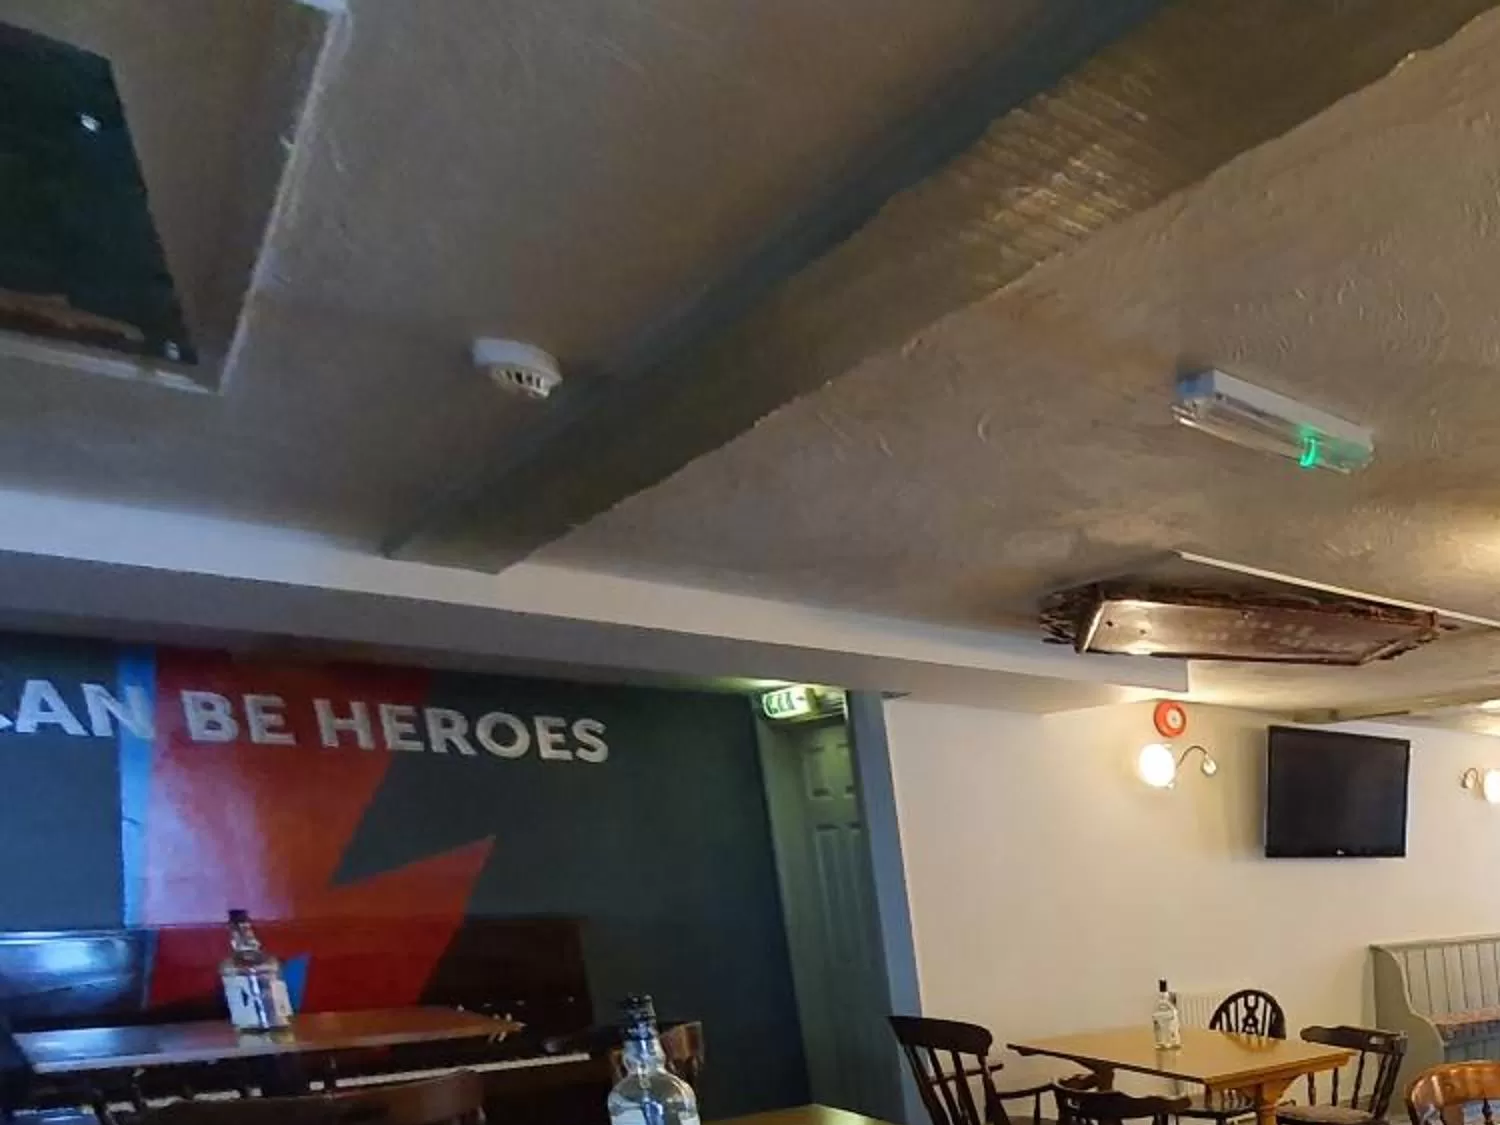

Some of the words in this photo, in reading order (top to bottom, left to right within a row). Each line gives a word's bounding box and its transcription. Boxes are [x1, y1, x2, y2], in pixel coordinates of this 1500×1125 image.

[0, 679, 153, 741] AN
[180, 689, 296, 746] BE
[312, 697, 610, 763] HEROES
